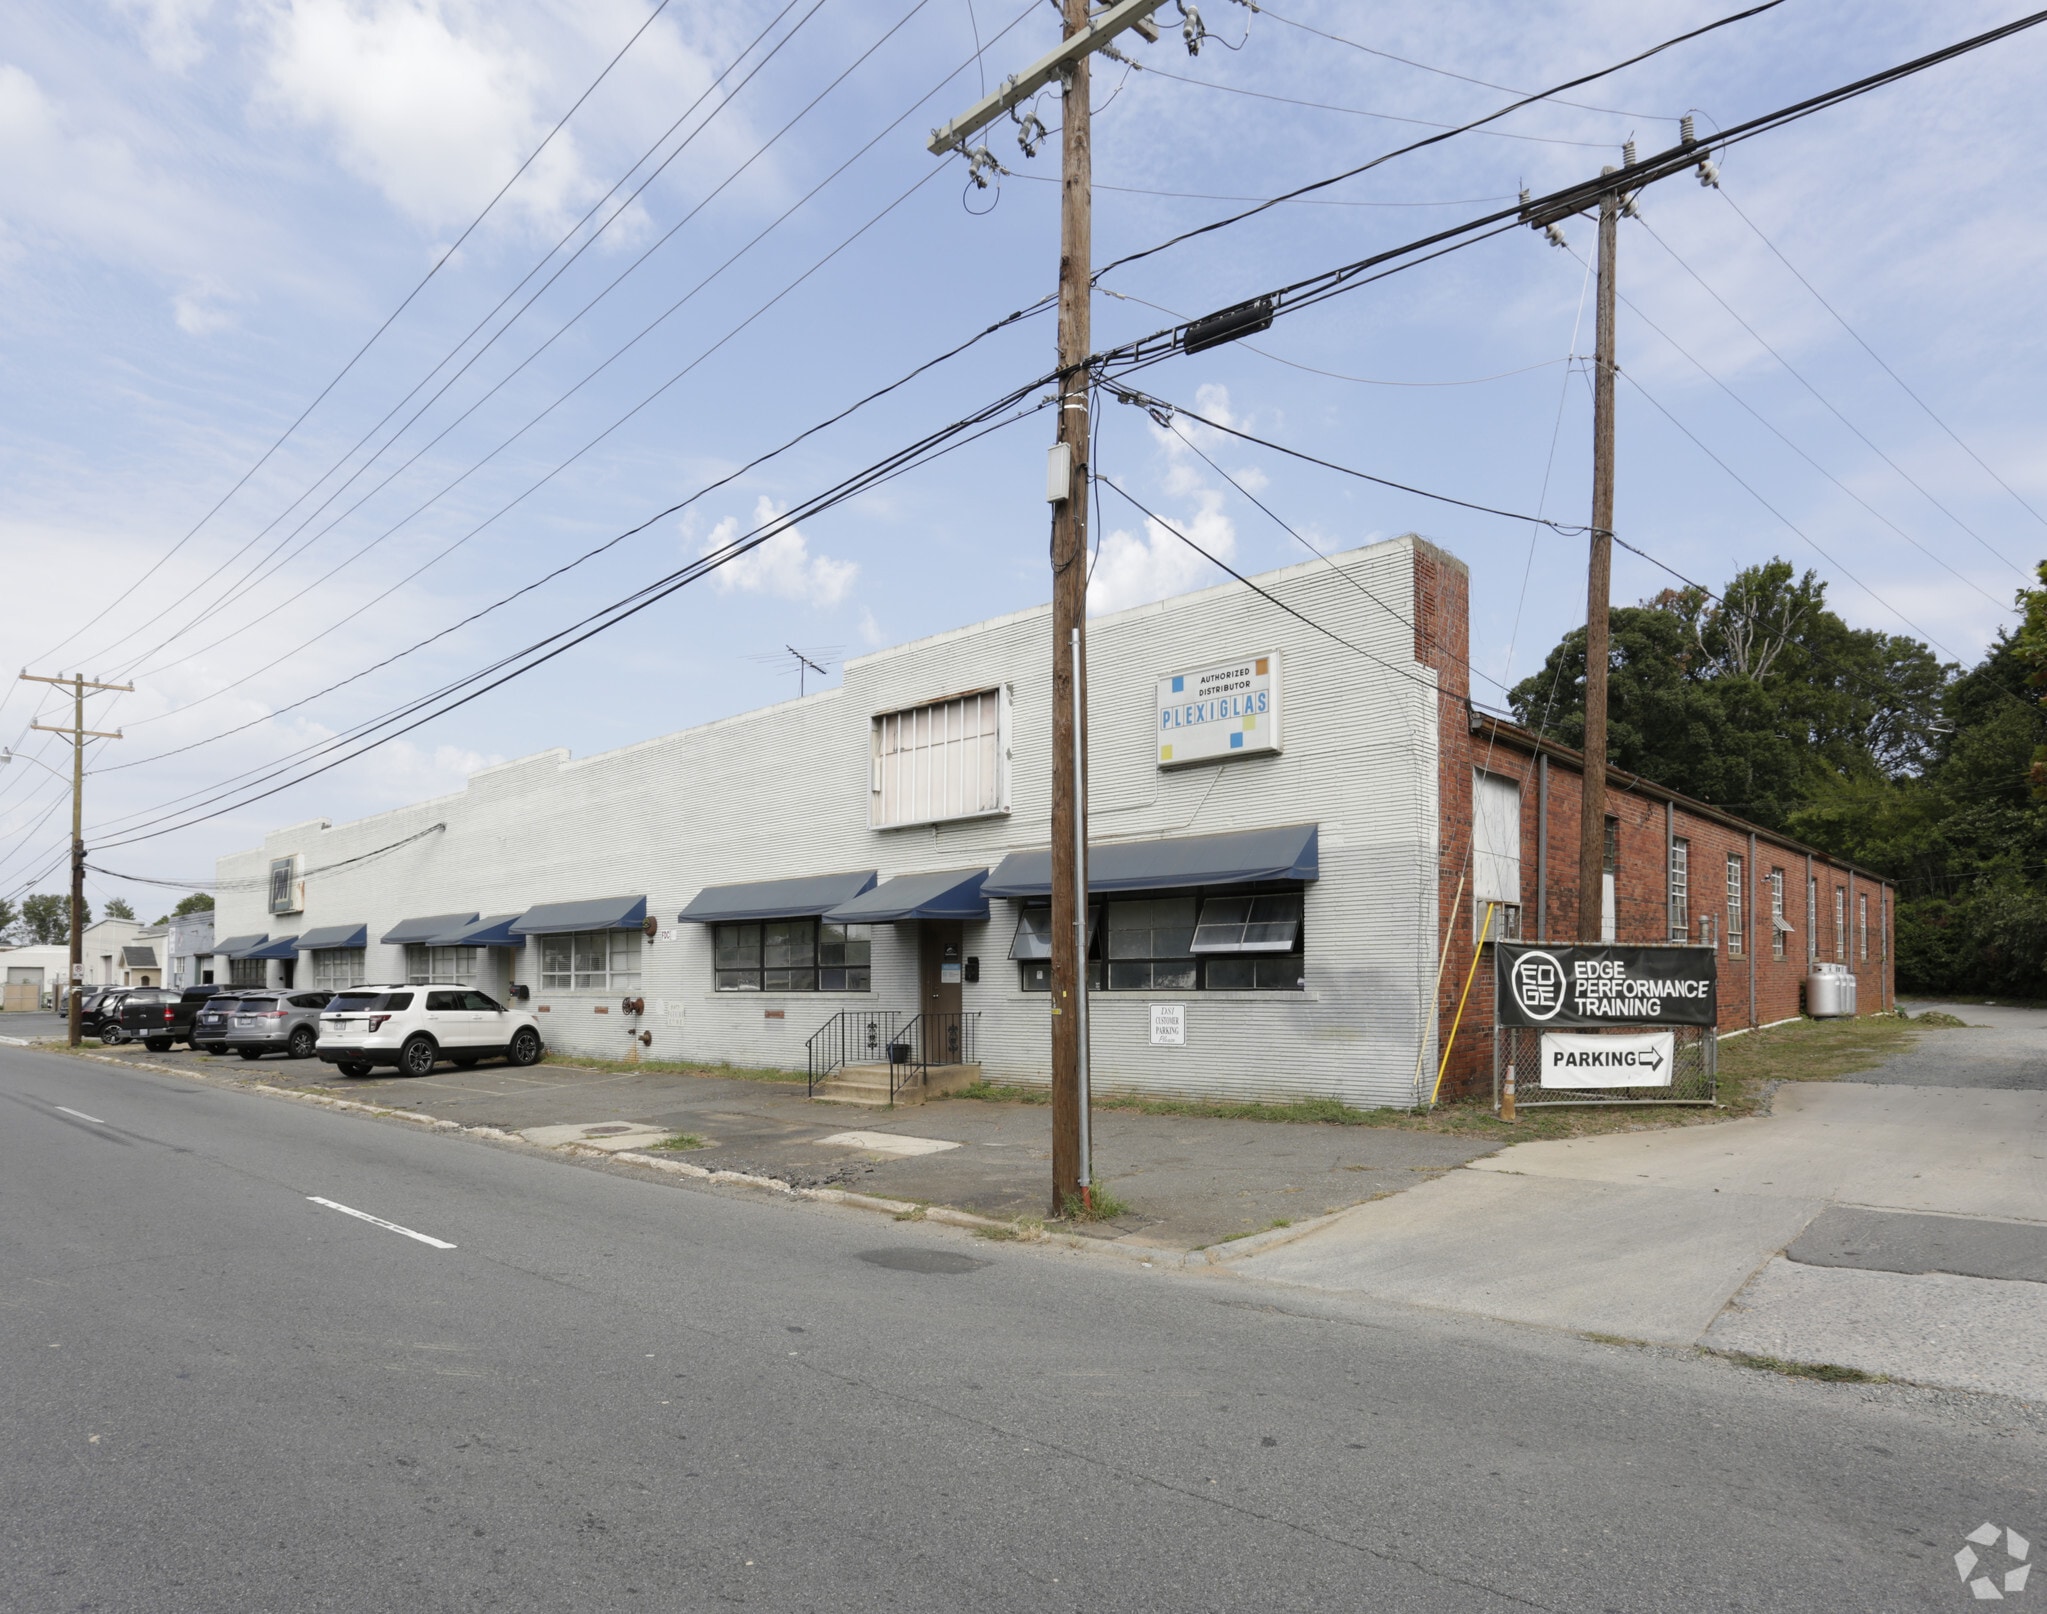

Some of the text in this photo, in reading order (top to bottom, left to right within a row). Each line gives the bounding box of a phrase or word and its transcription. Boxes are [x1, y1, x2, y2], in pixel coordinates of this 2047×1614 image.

[1200, 668, 1250, 684] AUTHORIZED
[1199, 680, 1251, 696] DISTRIBUTOR
[1163, 692, 1266, 728] PLEXIGLAS
[1574, 961, 1626, 978] EDGE
[1575, 980, 1709, 998] PERFORMANCE
[1574, 998, 1661, 1016] TRAINING
[1155, 1016, 1179, 1025] CUSTOMER
[1155, 1026, 1179, 1035] PARKING
[1553, 1051, 1636, 1067] PARKING
